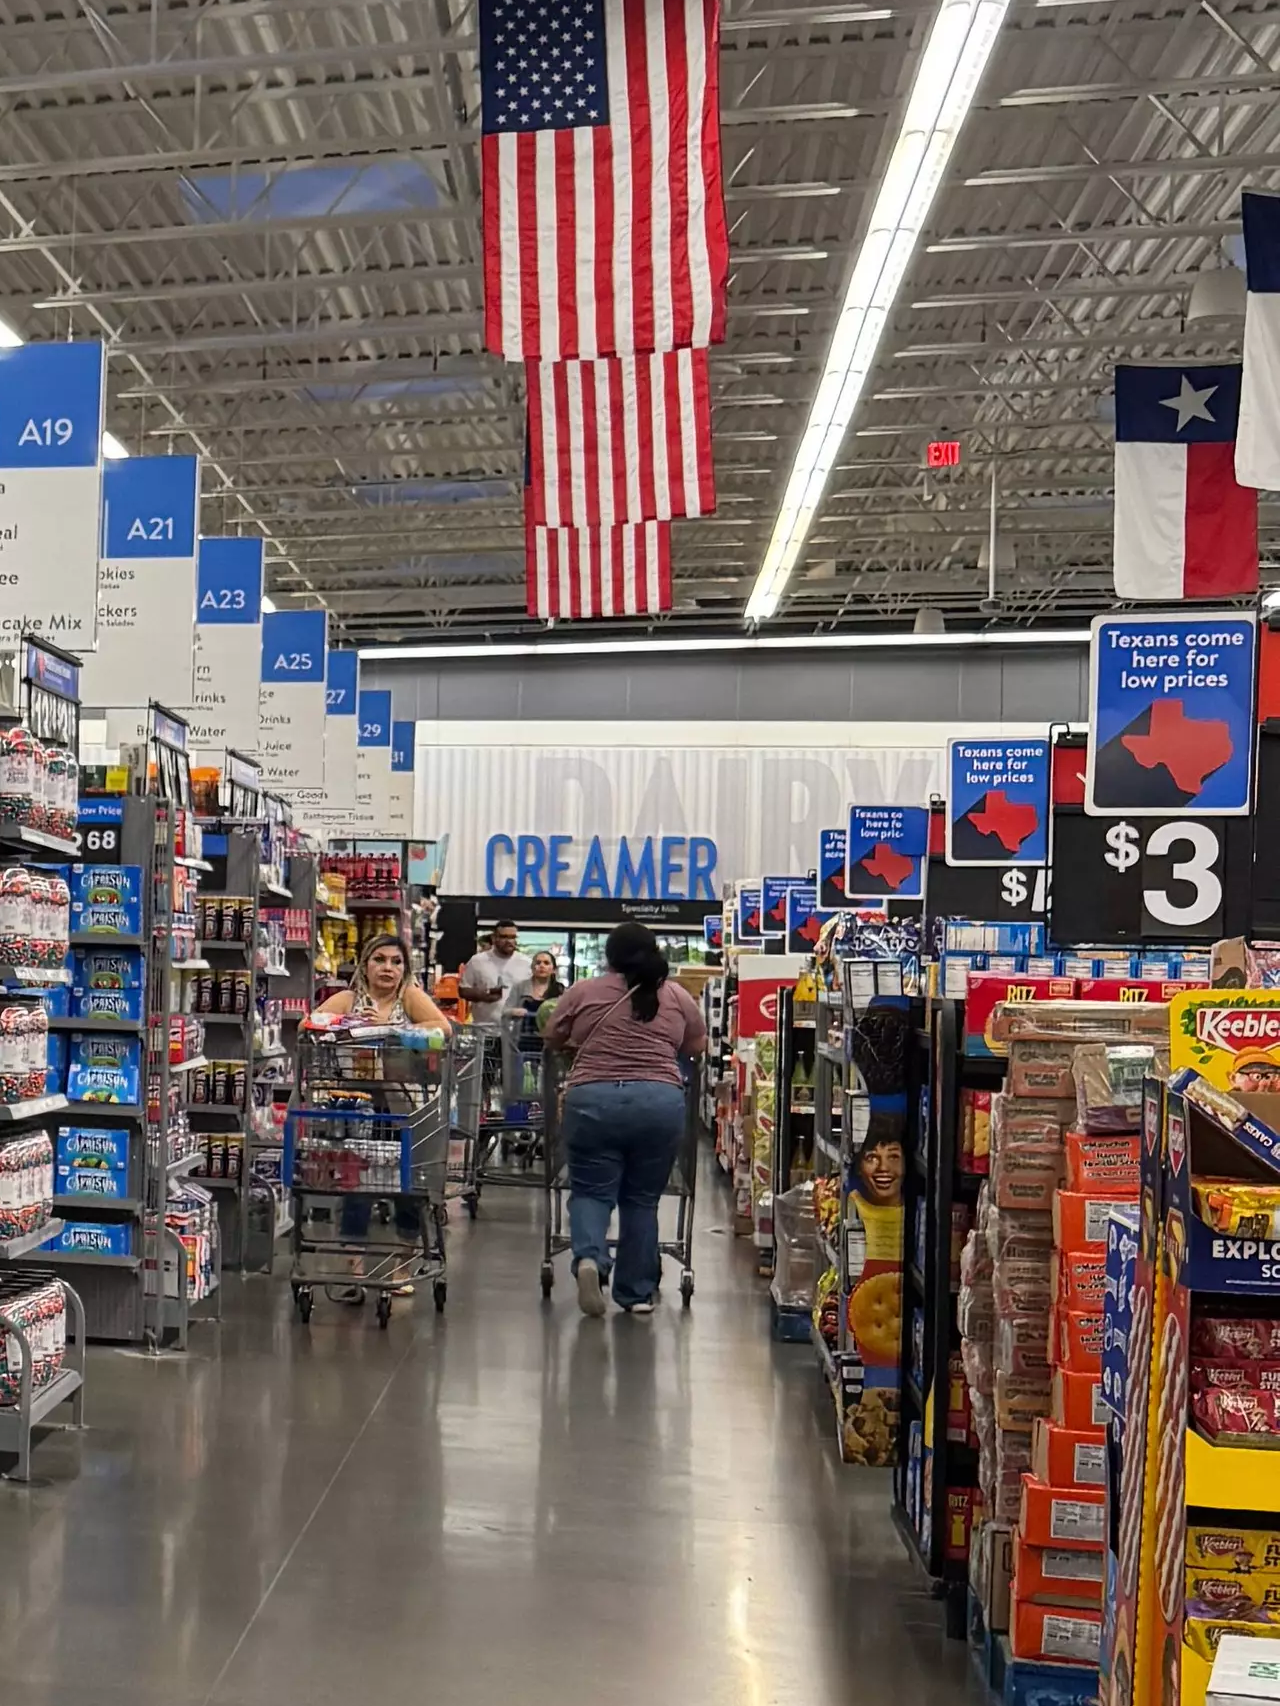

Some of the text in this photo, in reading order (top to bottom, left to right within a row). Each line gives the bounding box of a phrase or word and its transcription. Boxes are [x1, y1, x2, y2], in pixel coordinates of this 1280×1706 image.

[18, 419, 74, 447] A19
[127, 518, 173, 540] A21
[201, 590, 245, 608] A23
[50, 614, 82, 630] Mix
[1109, 631, 1244, 649] Texans come
[274, 654, 312, 669] A25
[1132, 650, 1218, 668] here for
[1122, 670, 1228, 692] low prices
[327, 690, 345, 703] 27
[190, 726, 226, 736] Water
[958, 746, 1044, 759] Texans come
[973, 758, 1028, 771] here for
[966, 771, 1034, 786] low prices
[99, 806, 122, 815] Price
[486, 833, 717, 900] CREAMER
[1007, 985, 1036, 1001] RITZ
[1120, 988, 1148, 1002] RITZ
[1200, 1009, 1280, 1042] Keeble
[1243, 1122, 1273, 1147] CAKES
